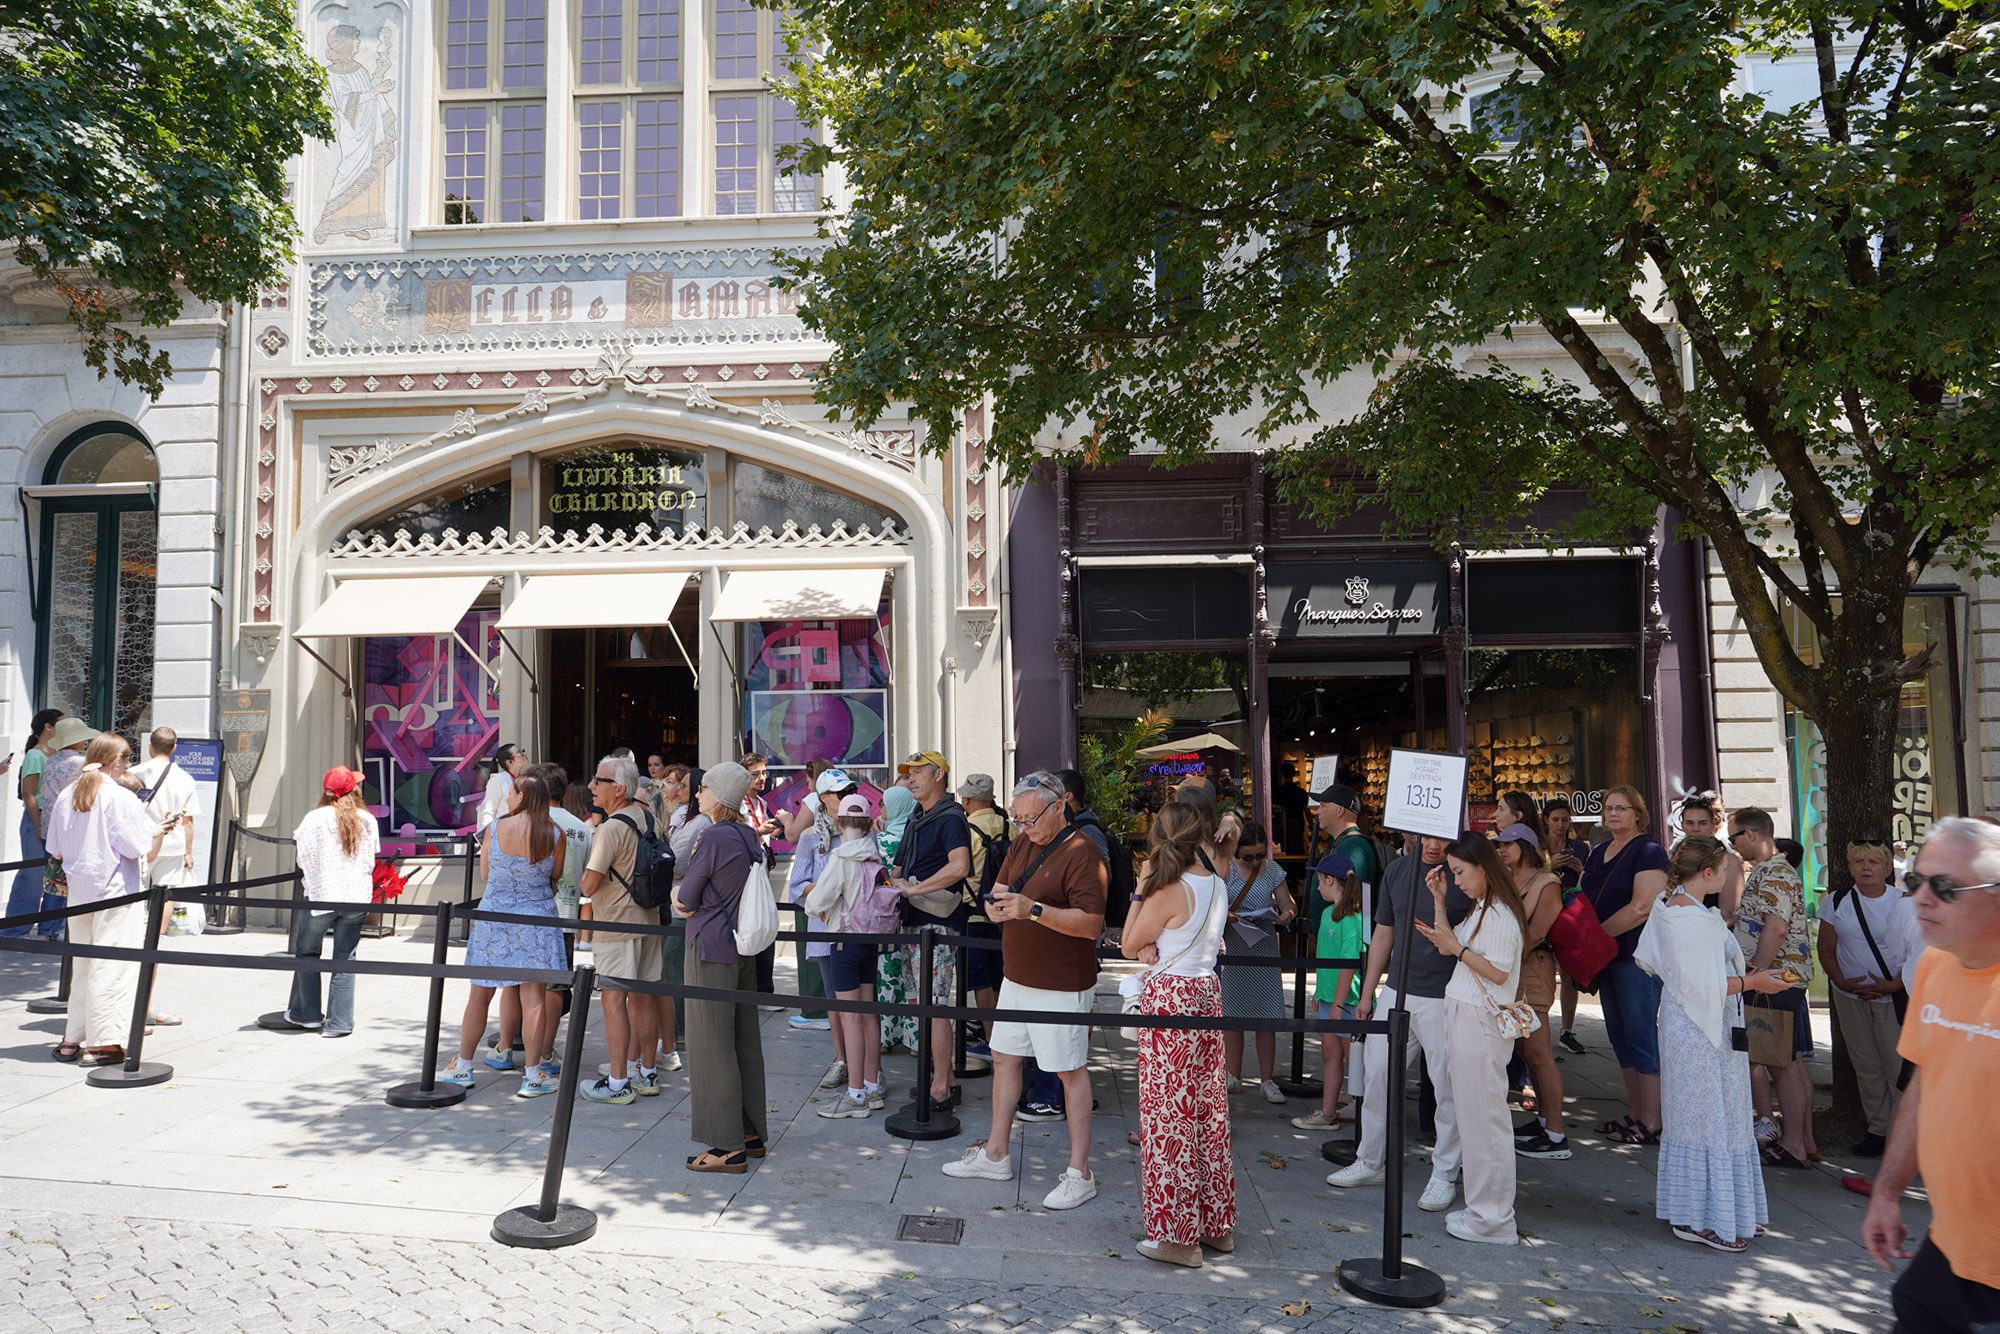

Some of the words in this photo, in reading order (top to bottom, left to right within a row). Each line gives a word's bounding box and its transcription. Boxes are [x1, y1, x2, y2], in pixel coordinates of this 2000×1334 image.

[562, 465, 685, 487] LIVRARIA
[549, 490, 697, 514] CHARDRON
[1294, 598, 1366, 623] Marques
[1366, 602, 1423, 619] Soares
[1406, 784, 1442, 809] 13:15
